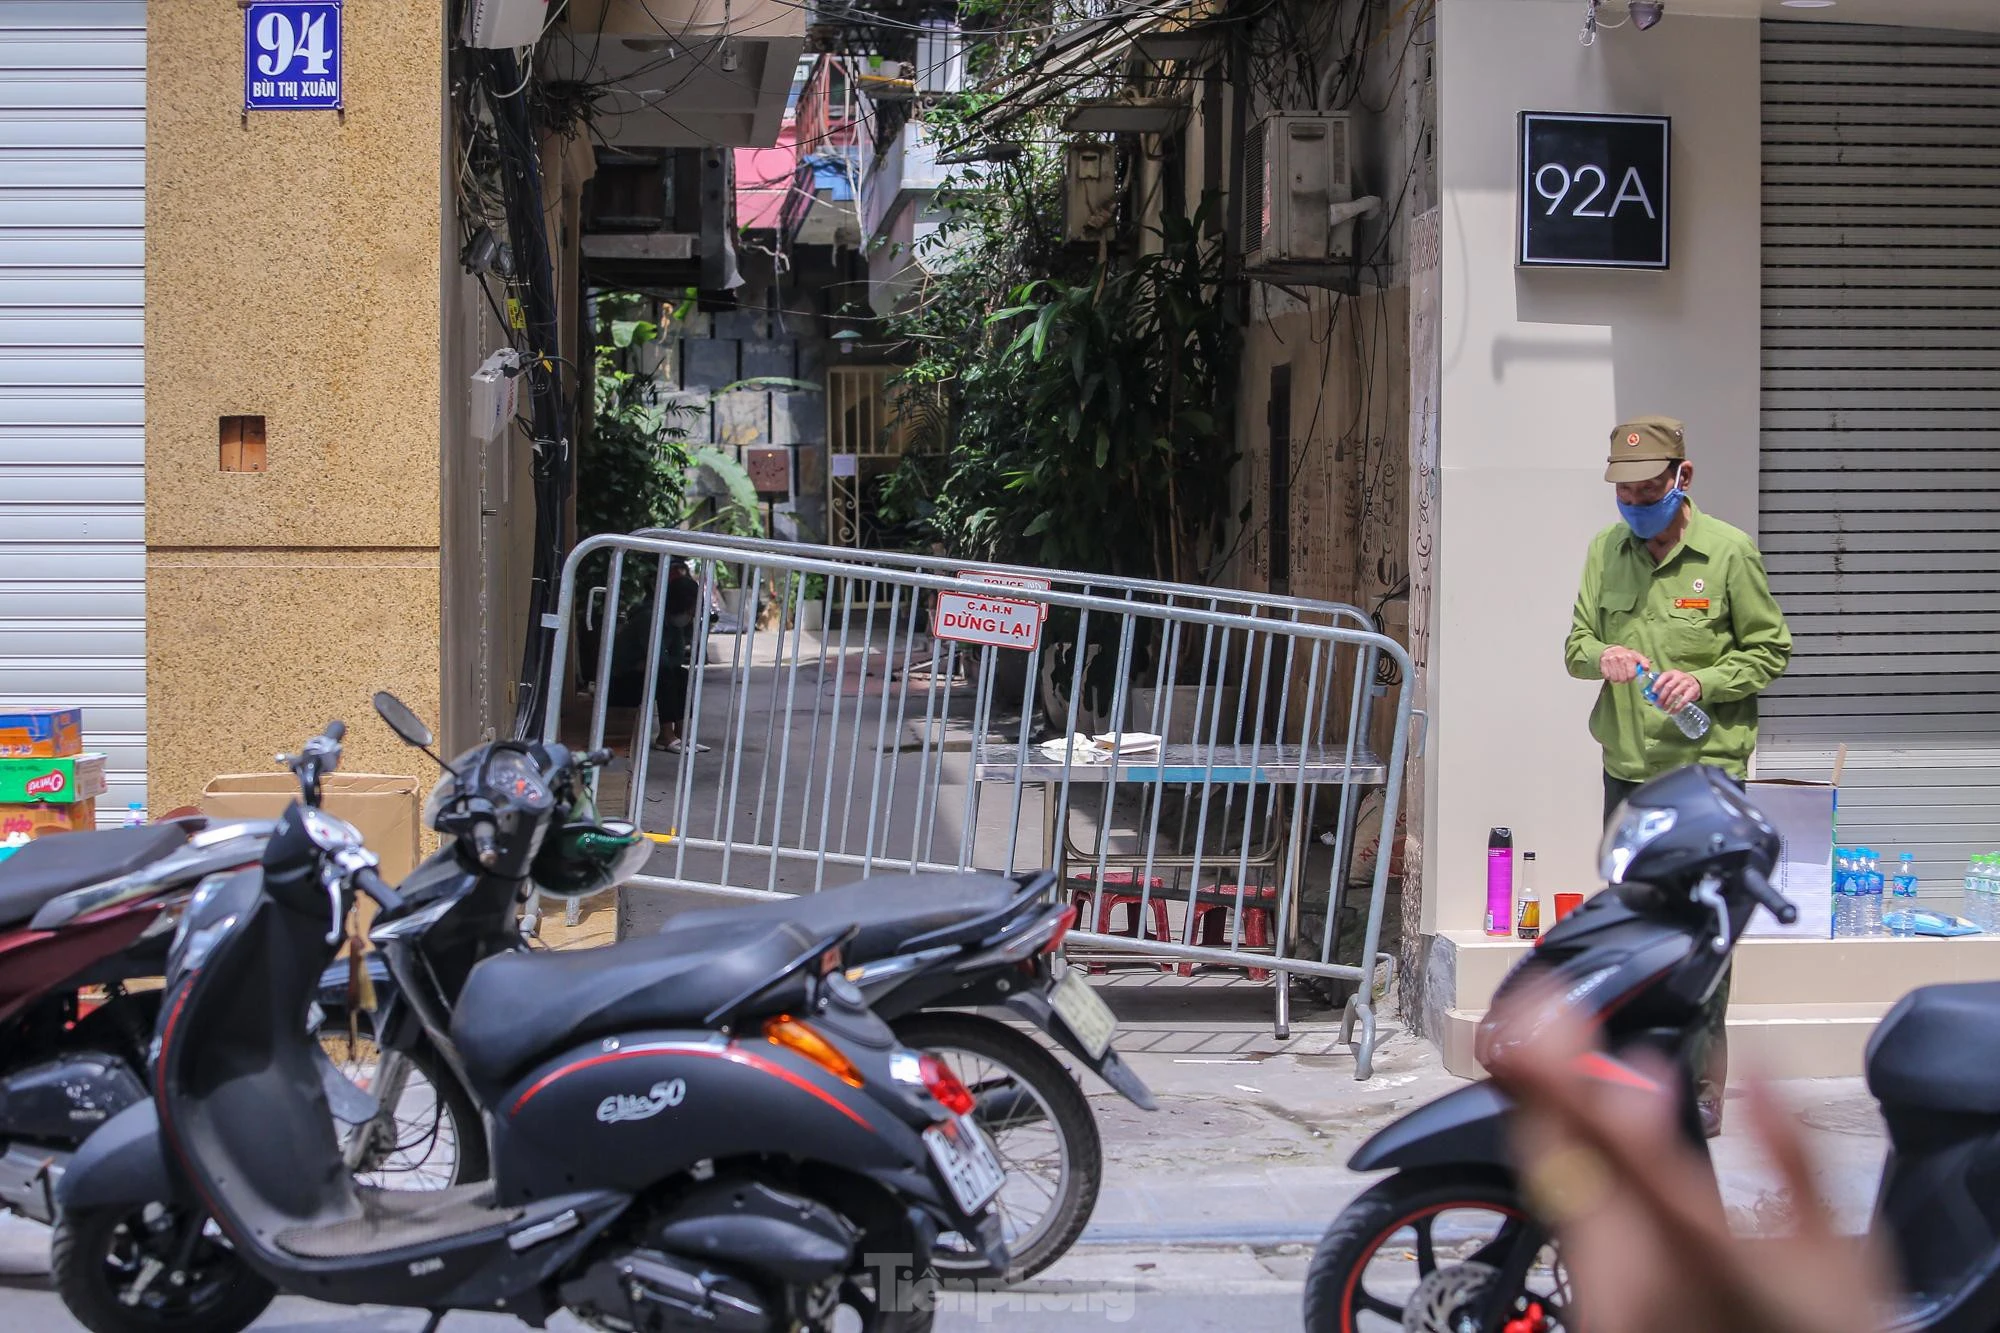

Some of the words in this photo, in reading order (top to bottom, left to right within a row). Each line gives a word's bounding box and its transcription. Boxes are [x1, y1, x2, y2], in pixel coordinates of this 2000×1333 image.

[257, 12, 333, 76] 94
[253, 79, 275, 97] BÙI
[278, 81, 298, 100] THỊ
[301, 78, 336, 97] XUÂN
[1535, 162, 1656, 219] 92A
[967, 601, 1012, 615] C.A.H.N
[943, 610, 996, 632] DỪNG
[999, 620, 1031, 639] LẠI
